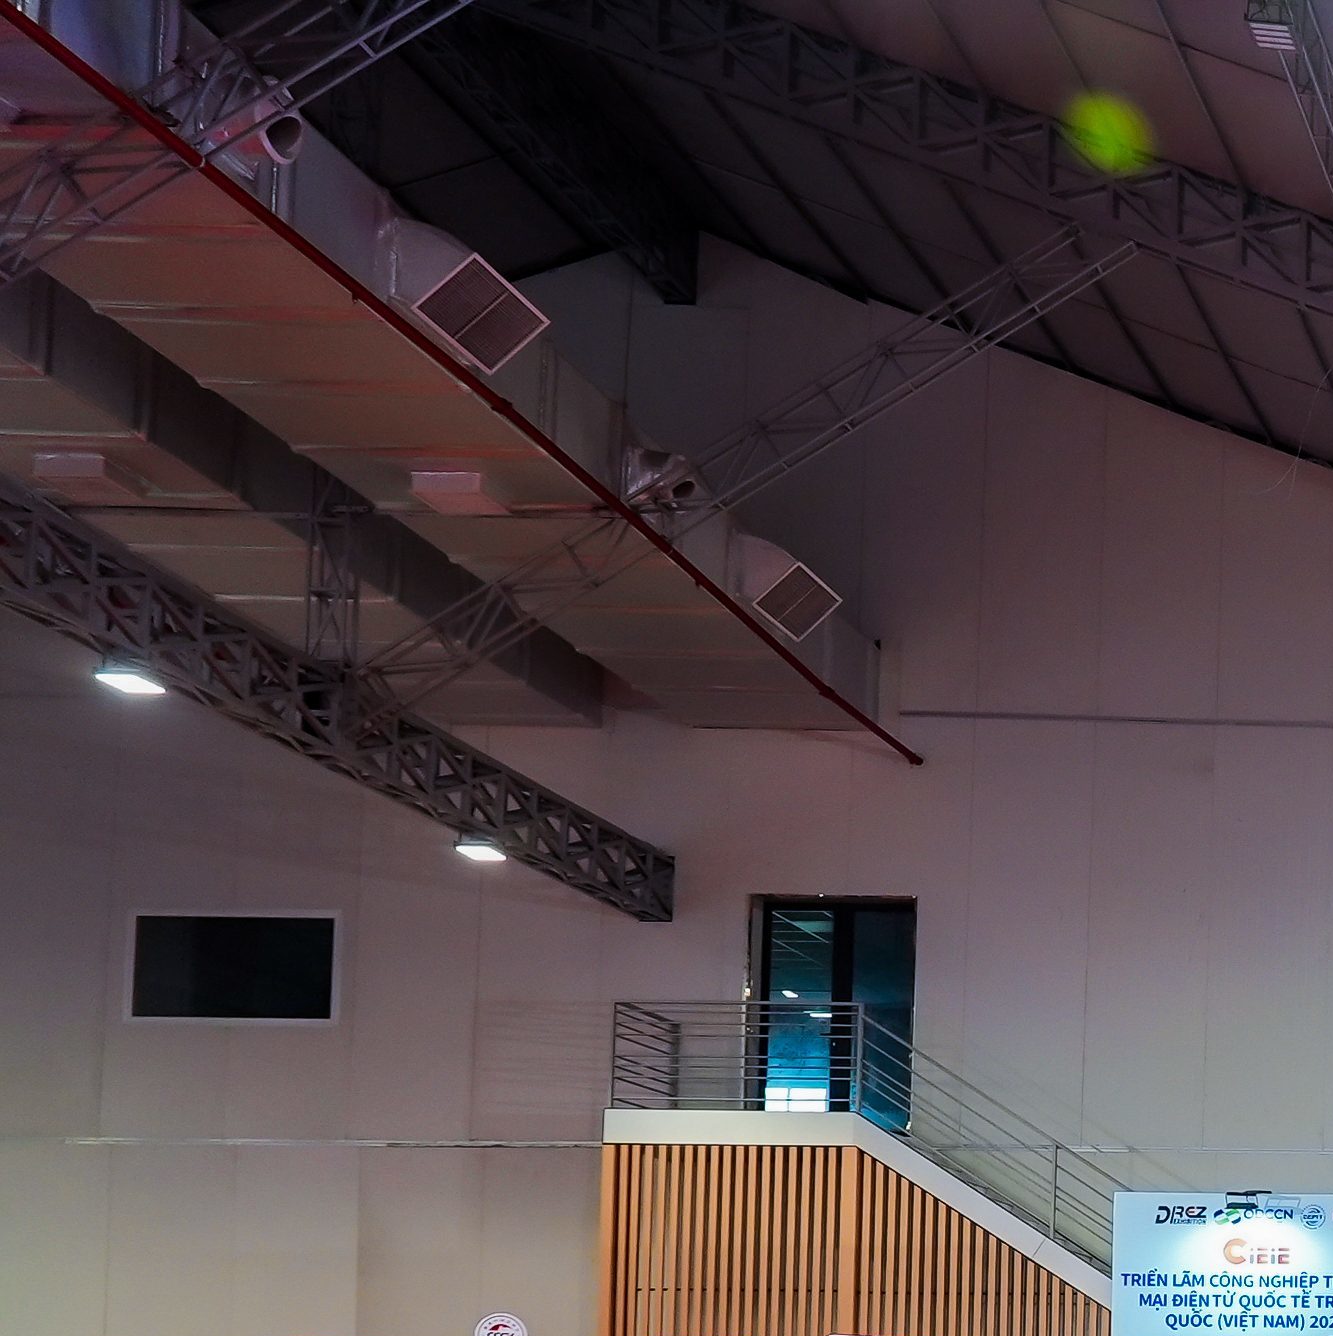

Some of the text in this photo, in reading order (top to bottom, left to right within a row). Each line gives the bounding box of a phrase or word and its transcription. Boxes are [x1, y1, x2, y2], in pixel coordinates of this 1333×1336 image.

[1209, 1271, 1254, 1288] CÔNG
[1139, 1293, 1168, 1311] MẠI
[1217, 1311, 1260, 1332] (VIỆT
[1263, 1314, 1305, 1331] NAM)
